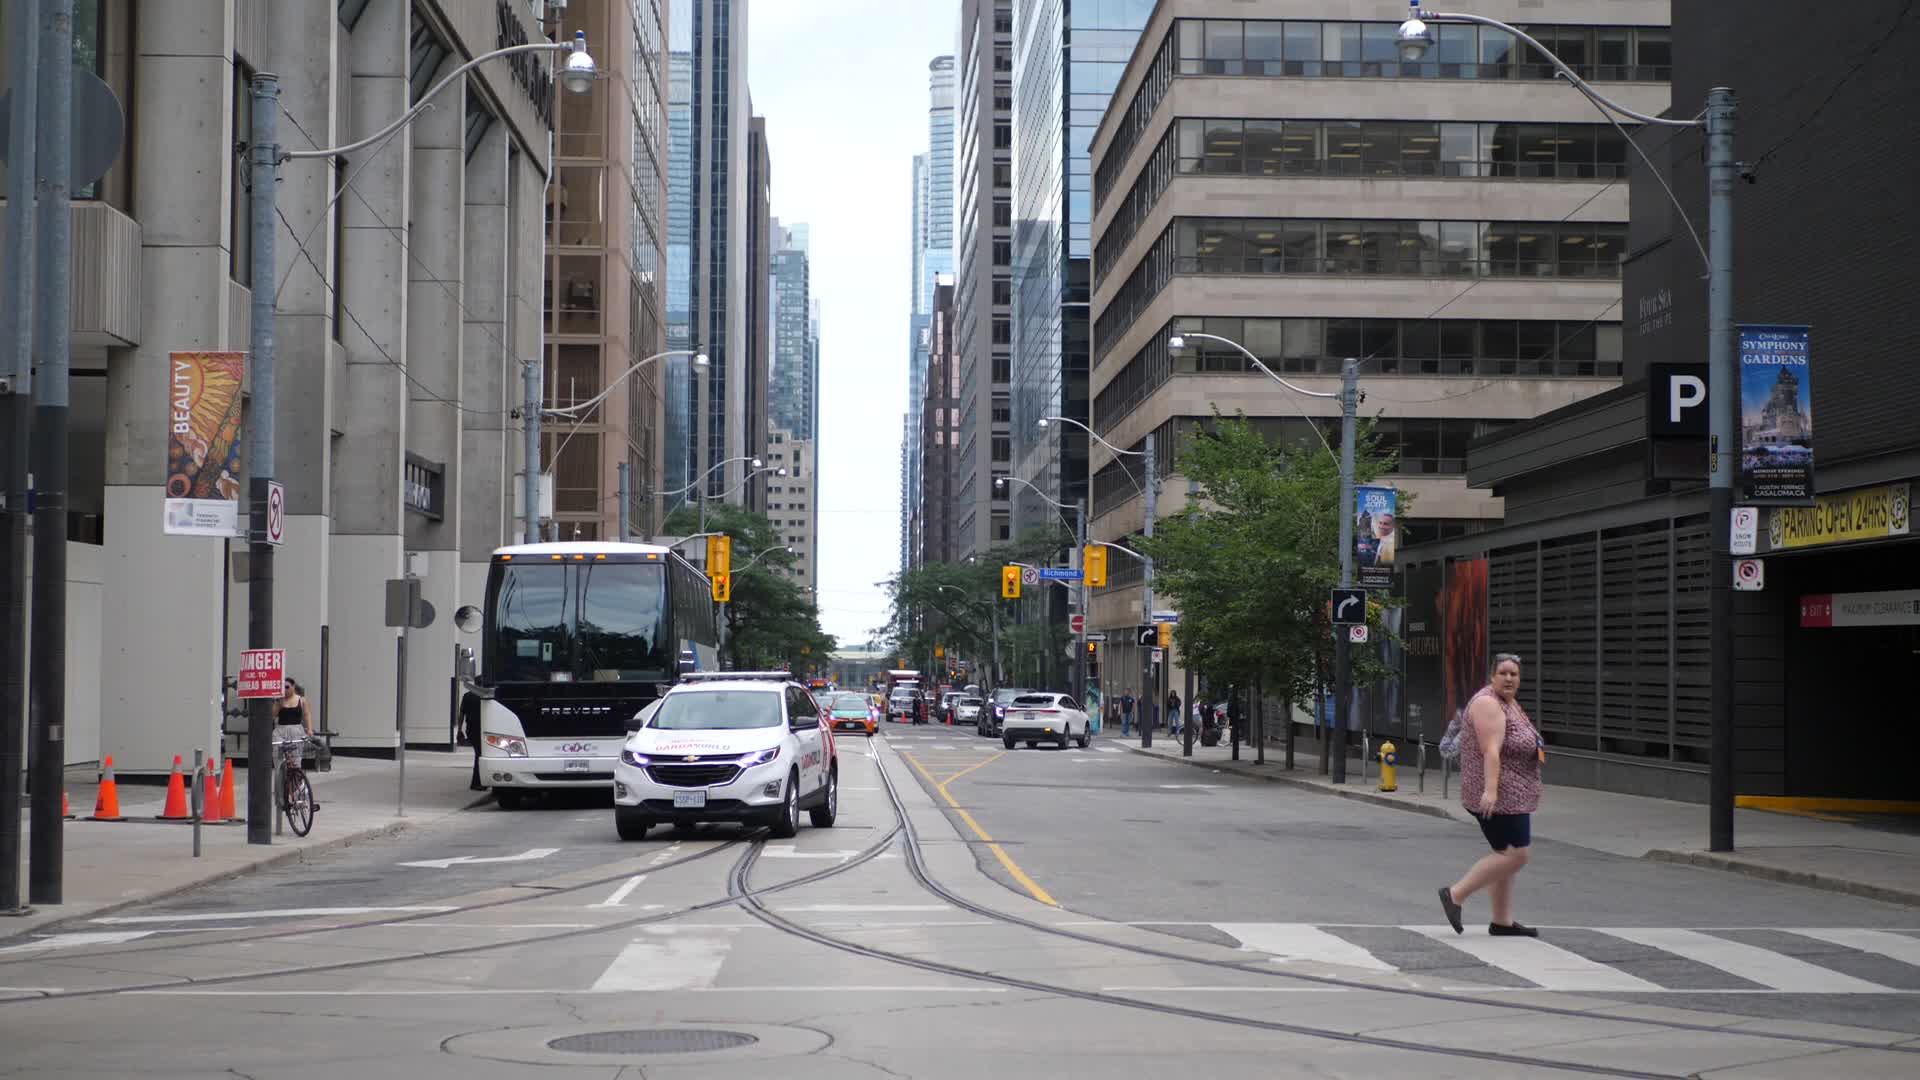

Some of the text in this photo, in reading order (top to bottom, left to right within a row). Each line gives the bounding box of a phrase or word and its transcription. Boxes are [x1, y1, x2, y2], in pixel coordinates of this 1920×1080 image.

[1742, 341, 1807, 350] SYMPHONY
[1743, 354, 1806, 365] GARDENS
[173, 360, 192, 434] BEAUTY
[1670, 375, 1706, 422] P
[1365, 494, 1386, 502] SOUL
[1784, 504, 1823, 540] PARKING
[1825, 502, 1853, 534] OPEN
[1856, 496, 1888, 531] 24HRS
[1734, 540, 1752, 548] ROUTE
[1043, 569, 1078, 577] Richmond
[258, 671, 267, 679] TO
[541, 707, 611, 715] PREVOST
